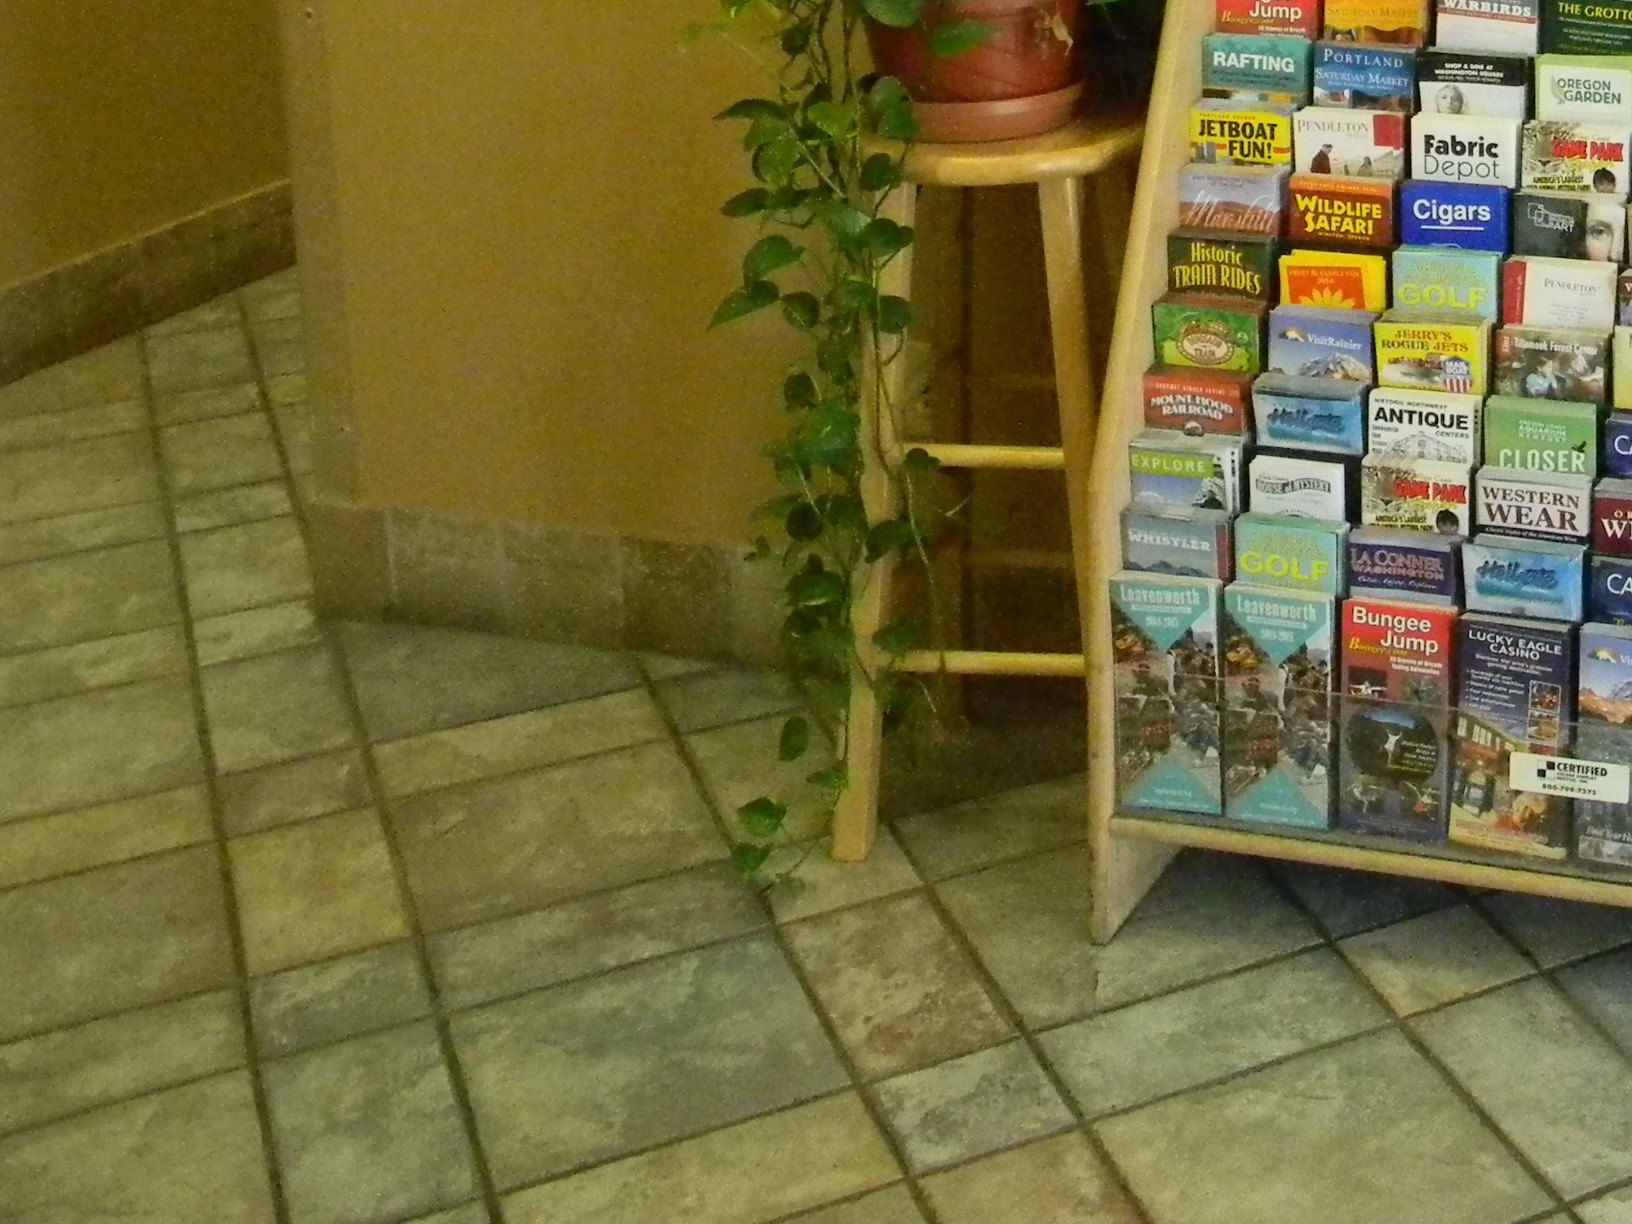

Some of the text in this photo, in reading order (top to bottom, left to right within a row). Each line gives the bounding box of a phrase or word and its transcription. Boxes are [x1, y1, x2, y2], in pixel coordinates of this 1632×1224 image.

[1249, 1, 1302, 23] Jump
[1558, 2, 1580, 16] THE
[1213, 51, 1295, 73] RAFTING
[1324, 48, 1403, 68] PORTLAND
[1557, 77, 1611, 90] OREGON
[1564, 89, 1621, 105] GARDEN
[1198, 119, 1278, 141] JETBOAT
[1297, 119, 1369, 133] PENDLETON
[1228, 141, 1273, 159] FUN!
[1424, 134, 1499, 159] Fabric
[1424, 154, 1500, 180] Depot
[1295, 193, 1382, 220] WILDLIFE
[1413, 199, 1491, 225] Cigars
[1304, 212, 1374, 235] SAFARI
[1190, 242, 1242, 267] Historic
[1173, 265, 1261, 295] TRAIN RIDES
[1398, 283, 1488, 310] GOLF
[1374, 407, 1469, 430] ANTIQUE
[1435, 430, 1470, 439] CENTERS
[1132, 454, 1205, 473] EXPLORE
[1500, 448, 1586, 472] CLOSER
[1481, 485, 1580, 509] WESTERN
[1484, 502, 1578, 533] WEAR
[1128, 529, 1211, 551] WHISTLER
[1239, 551, 1329, 582] GOLF
[1353, 606, 1431, 633] Bungee
[1380, 630, 1439, 656] Jump
[1469, 630, 1562, 655] LUCKY EAGLE
[1490, 644, 1540, 660] CASINO
[1557, 762, 1607, 777] CERTIFIED
